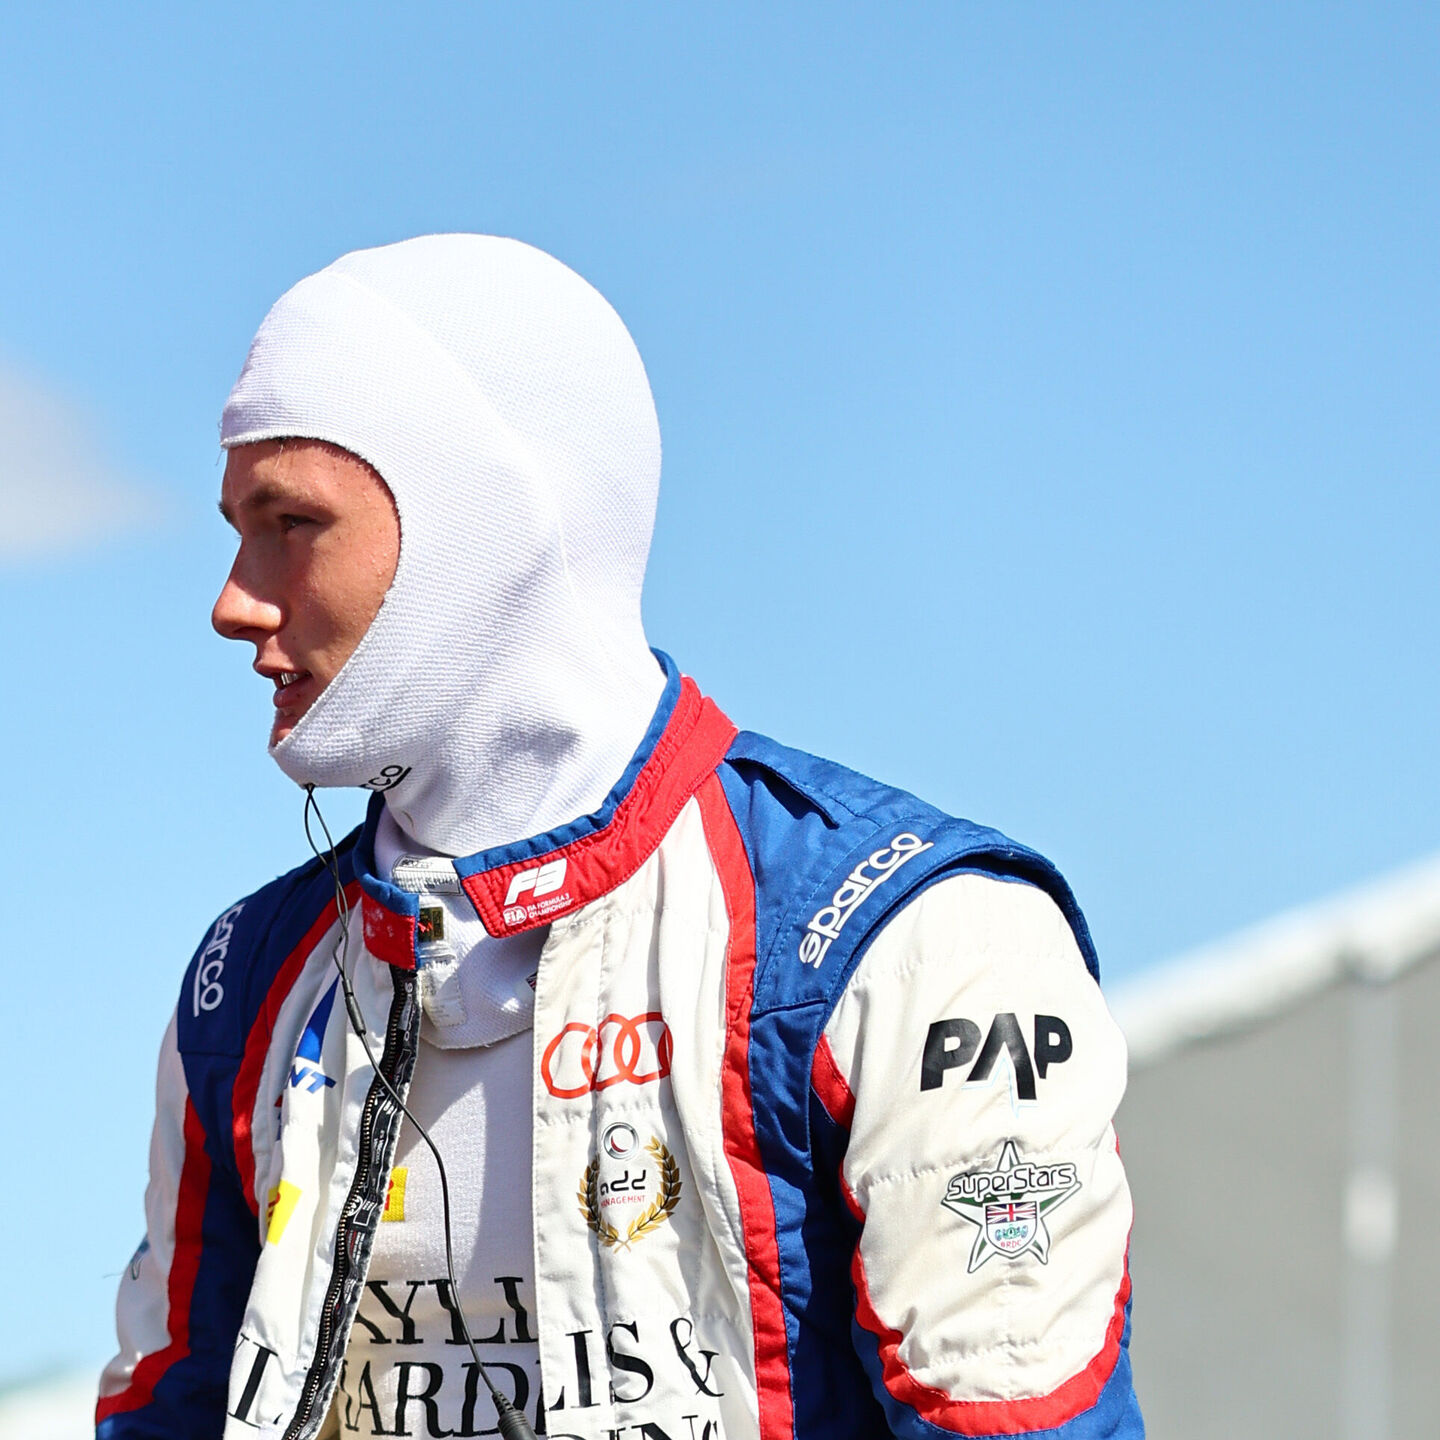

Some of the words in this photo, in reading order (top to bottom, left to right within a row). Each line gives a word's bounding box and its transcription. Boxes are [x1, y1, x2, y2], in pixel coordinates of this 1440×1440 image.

[504, 857, 567, 907] F3
[799, 832, 934, 969] sparco
[193, 903, 246, 1017] parco
[919, 1012, 1074, 1101] PAP
[669, 1317, 725, 1398] &
